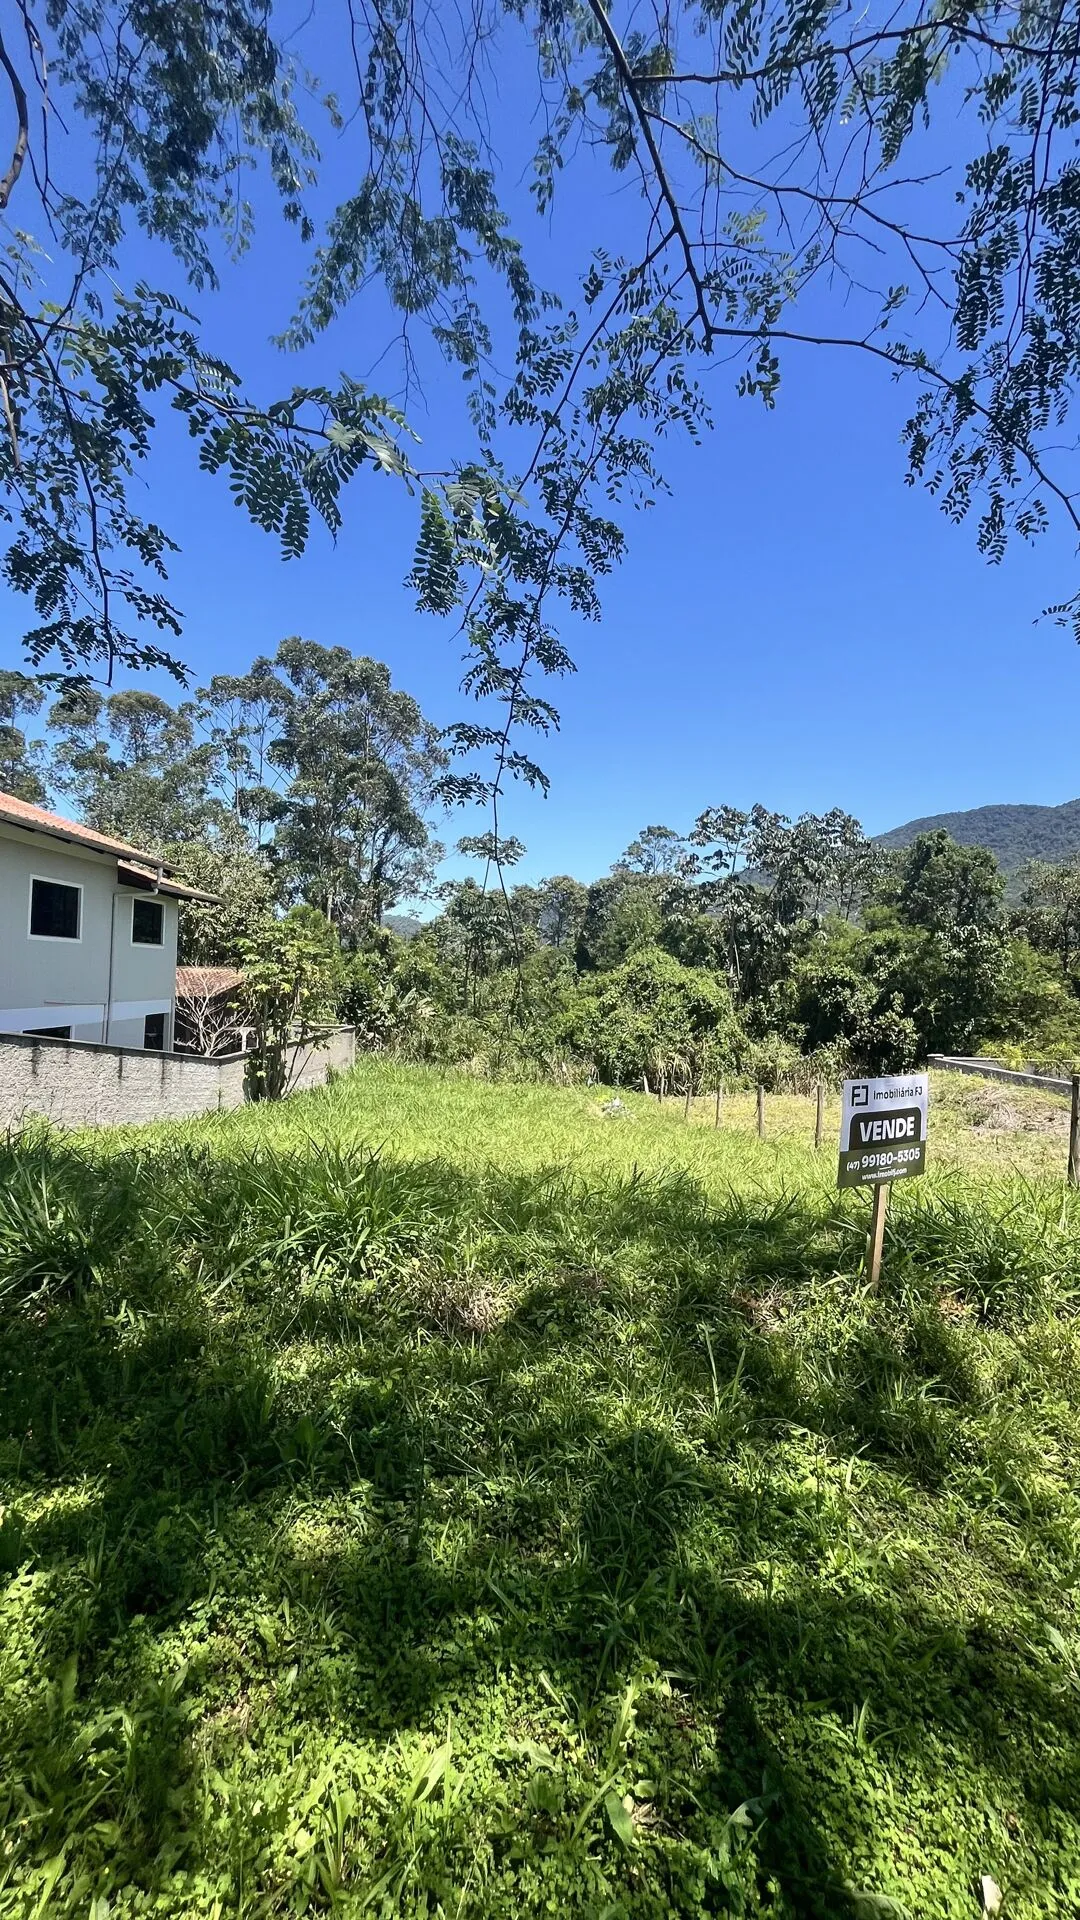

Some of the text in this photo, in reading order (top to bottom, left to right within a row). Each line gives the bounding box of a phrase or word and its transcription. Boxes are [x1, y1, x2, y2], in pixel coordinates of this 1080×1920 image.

[873, 1086, 923, 1100] Imobiliária FJ
[860, 1116, 915, 1142] VENDE
[846, 1147, 921, 1172] (47) 99180-5305
